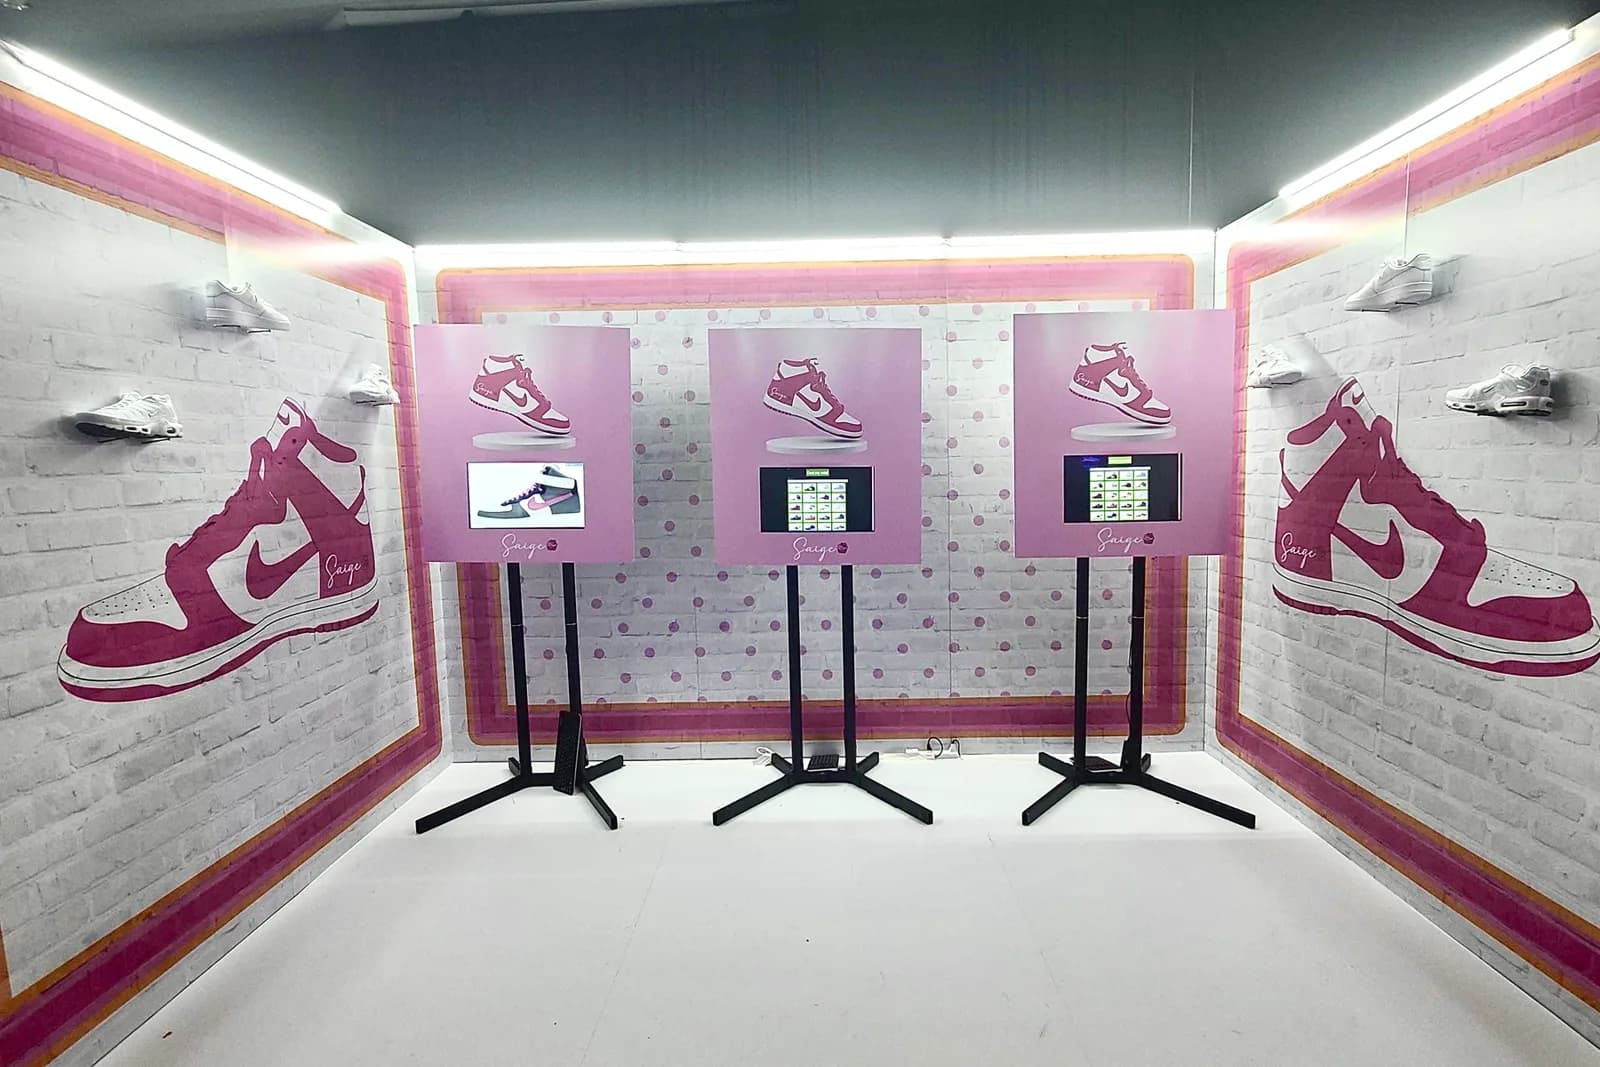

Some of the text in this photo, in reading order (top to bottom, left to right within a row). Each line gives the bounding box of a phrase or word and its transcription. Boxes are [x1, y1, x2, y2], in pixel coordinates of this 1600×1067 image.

[501, 533, 546, 560] Saige
[793, 536, 838, 562] Saige
[1097, 527, 1143, 553] Saige
[1281, 532, 1317, 569] Saige
[325, 554, 362, 589] Saige
